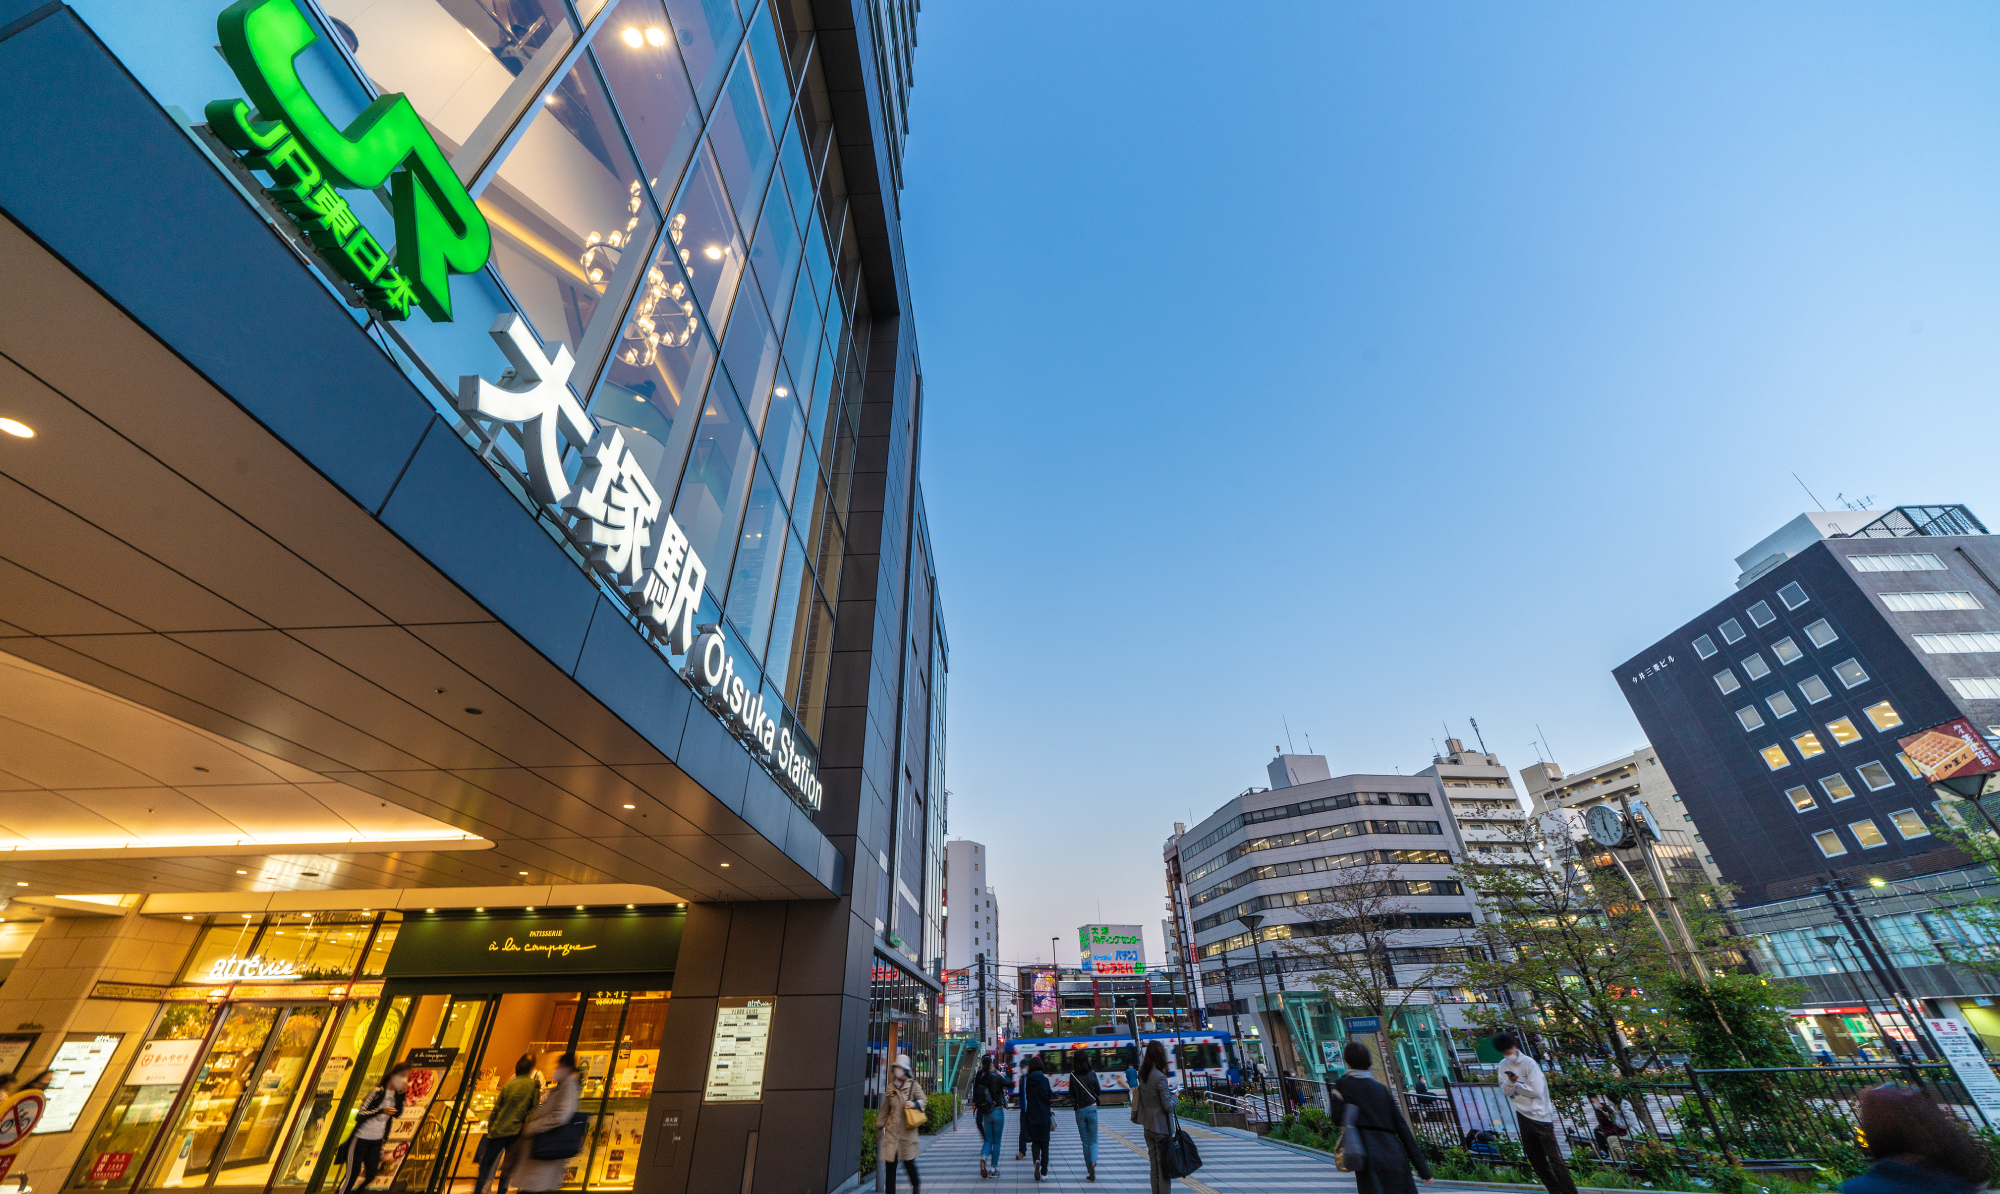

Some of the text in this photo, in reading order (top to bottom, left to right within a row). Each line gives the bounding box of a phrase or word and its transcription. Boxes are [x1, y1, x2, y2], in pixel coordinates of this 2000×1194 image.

[232, 100, 421, 321] JR東日本
[240, 0, 491, 323] JR
[474, 312, 708, 656] 大塚駅
[702, 624, 824, 812] Ōtsuka Station
[488, 937, 597, 958] à la campagne
[529, 930, 563, 938] PATISSERIE
